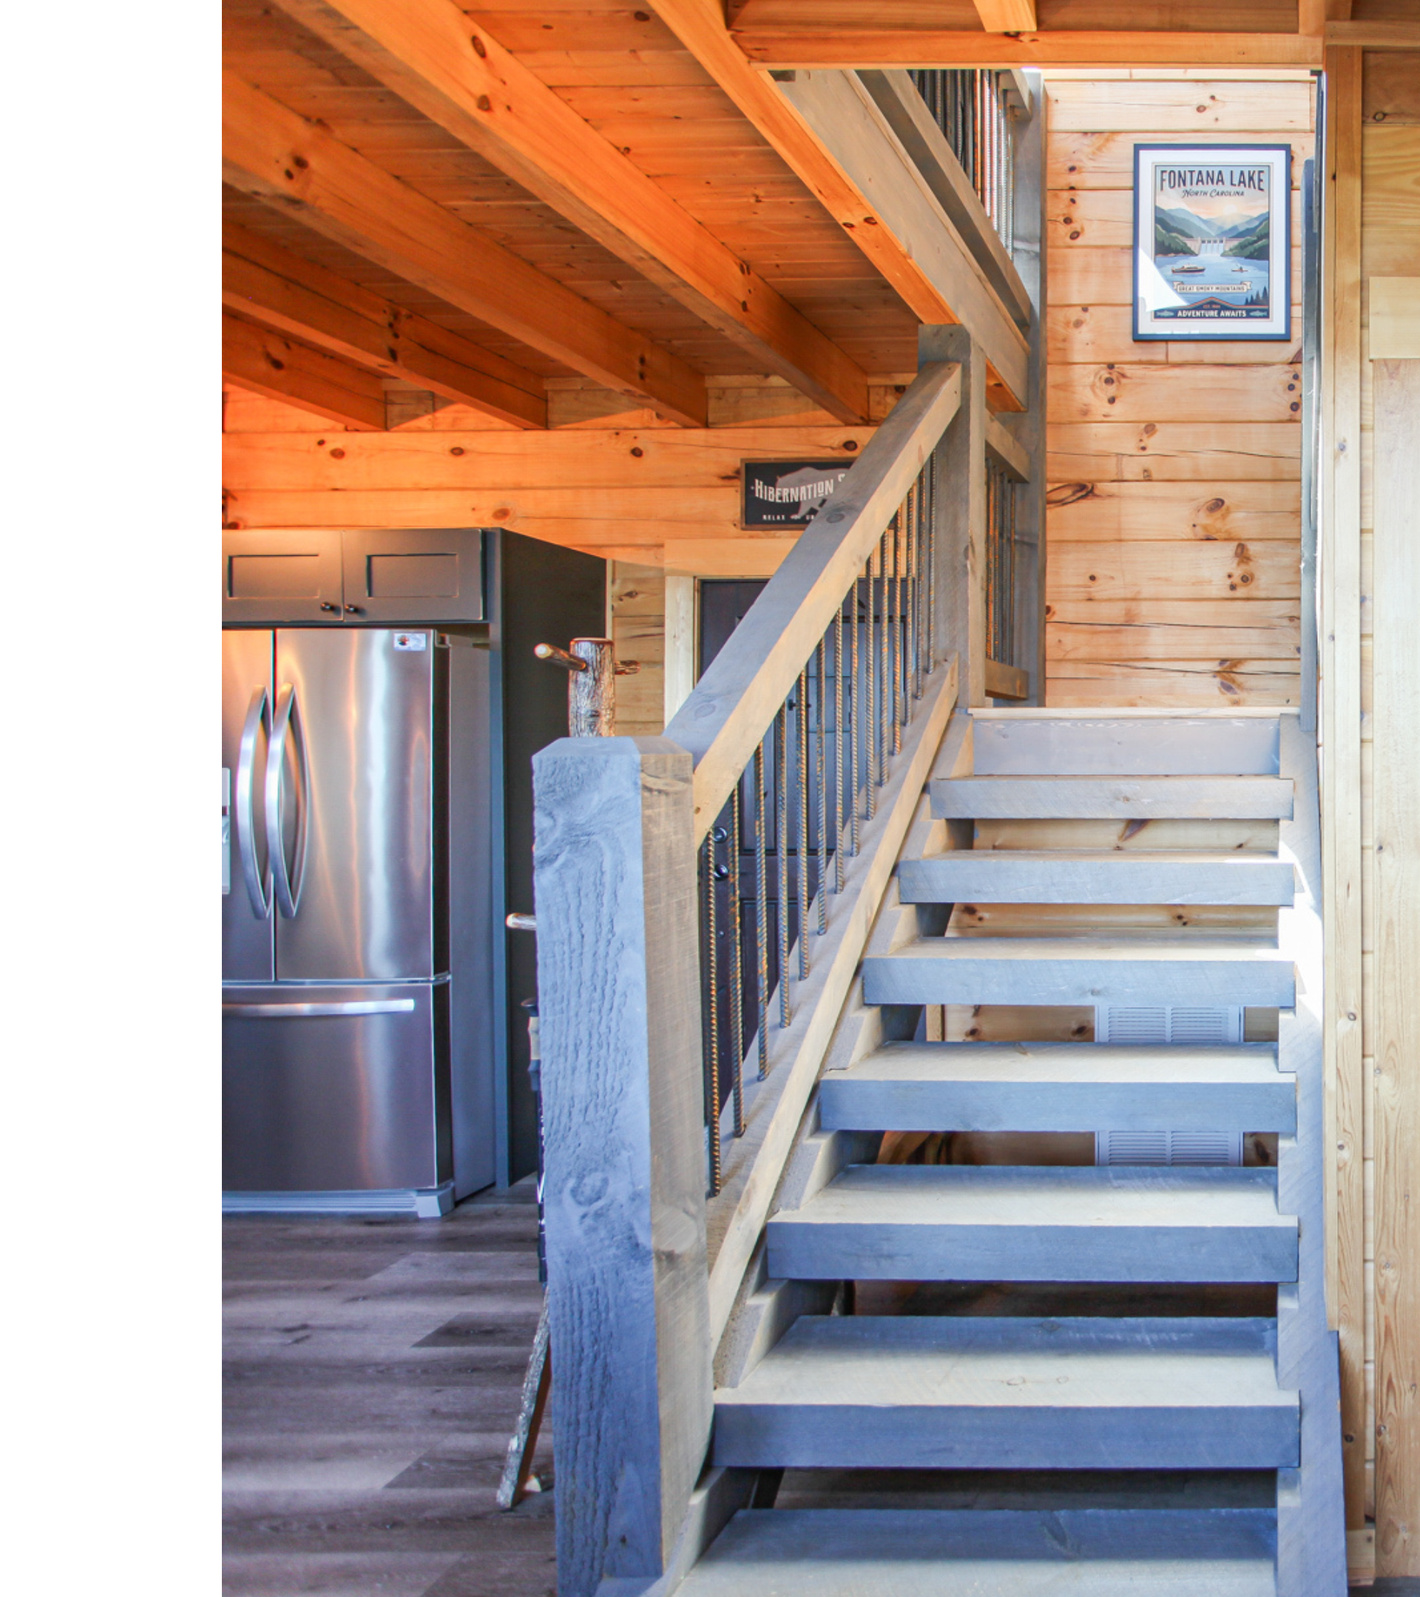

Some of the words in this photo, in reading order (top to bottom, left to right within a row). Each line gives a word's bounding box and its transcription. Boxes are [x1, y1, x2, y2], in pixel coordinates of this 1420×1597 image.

[1160, 170, 1225, 192] FONTANA
[1230, 170, 1265, 192] LAKE
[1182, 188, 1208, 198] NORTH
[1209, 189, 1244, 198] CAROLINA
[1177, 310, 1219, 318] ADVENTURE
[1220, 310, 1247, 318] AWAITS
[755, 479, 834, 503] HIBERNATION
